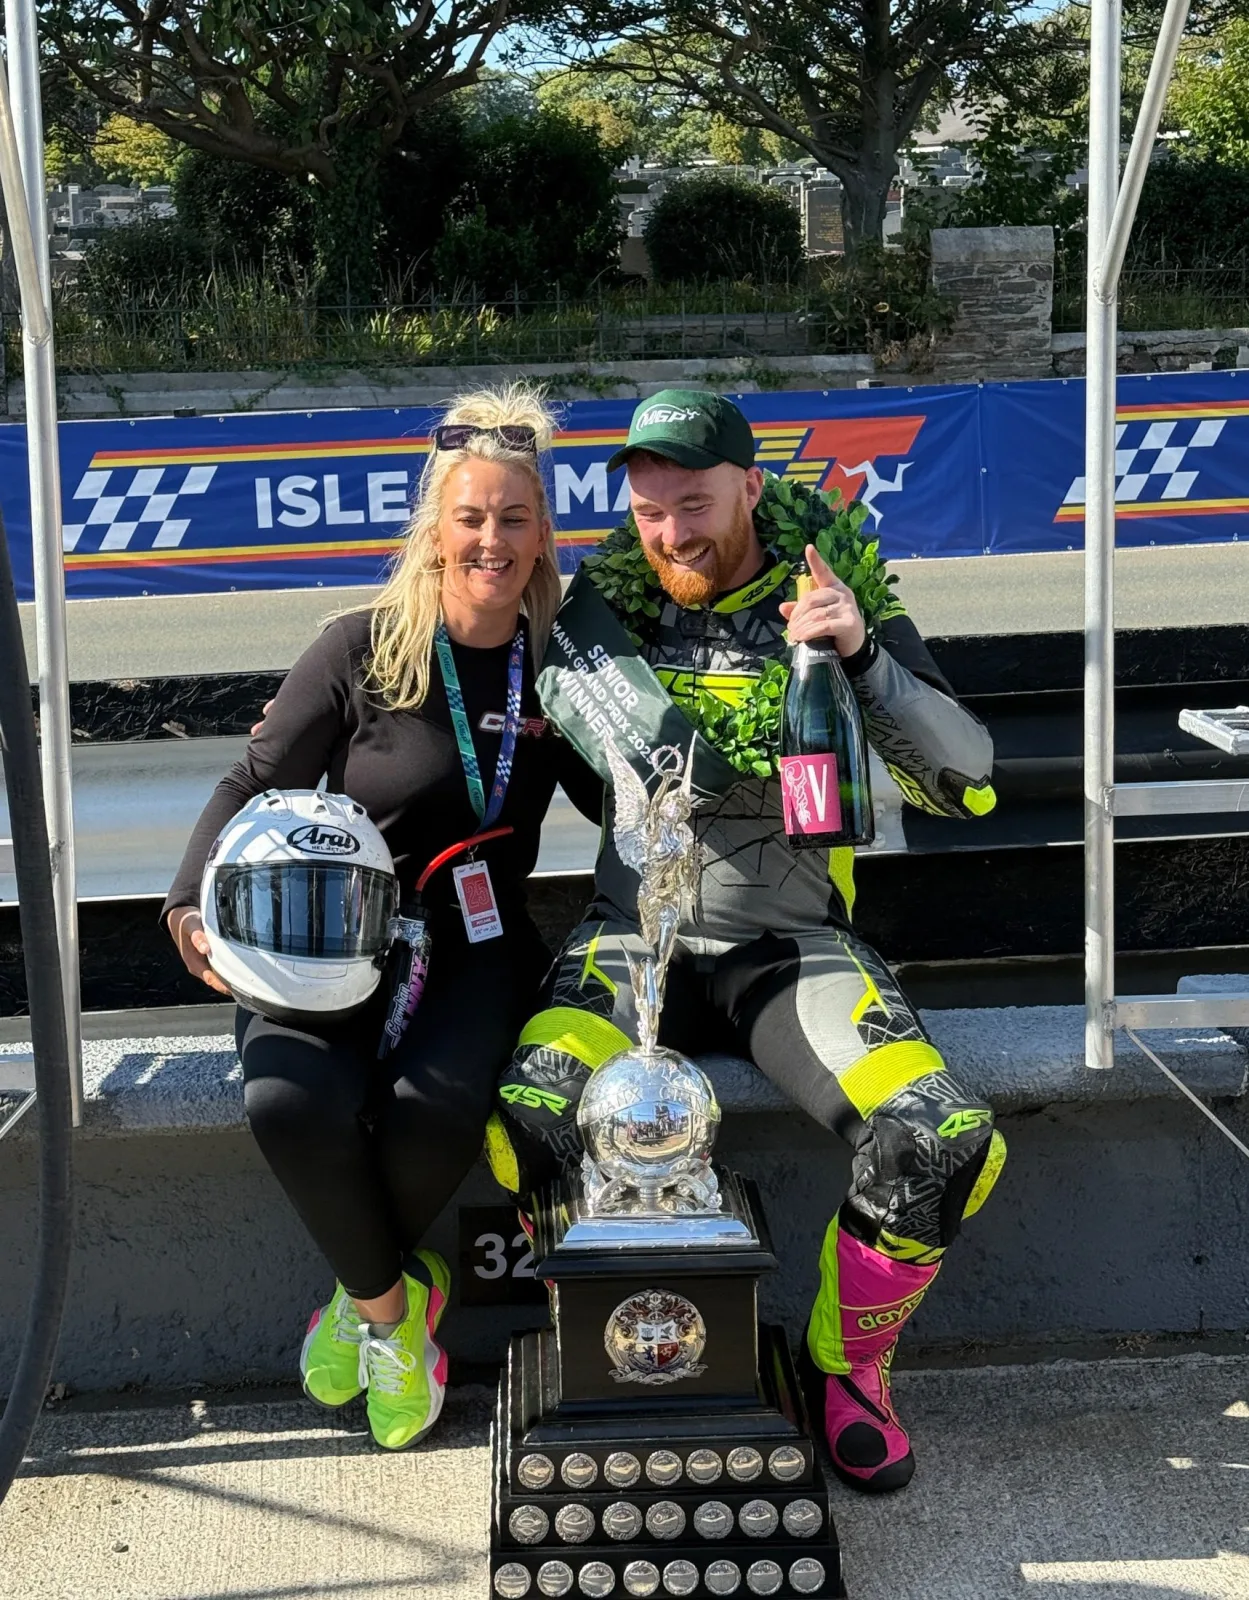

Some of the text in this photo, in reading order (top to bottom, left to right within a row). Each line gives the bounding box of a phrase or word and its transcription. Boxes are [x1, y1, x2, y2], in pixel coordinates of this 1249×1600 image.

[640, 409, 687, 429] MGP
[255, 470, 411, 529] ISLE
[551, 620, 578, 660] MANX
[573, 656, 607, 703] GRAND
[603, 699, 632, 734] PRIX
[556, 665, 615, 739] WINNER
[587, 644, 639, 713] SENIOR
[293, 826, 352, 849] Arai
[498, 1083, 573, 1117] 4SR
[473, 1232, 535, 1279] 32
